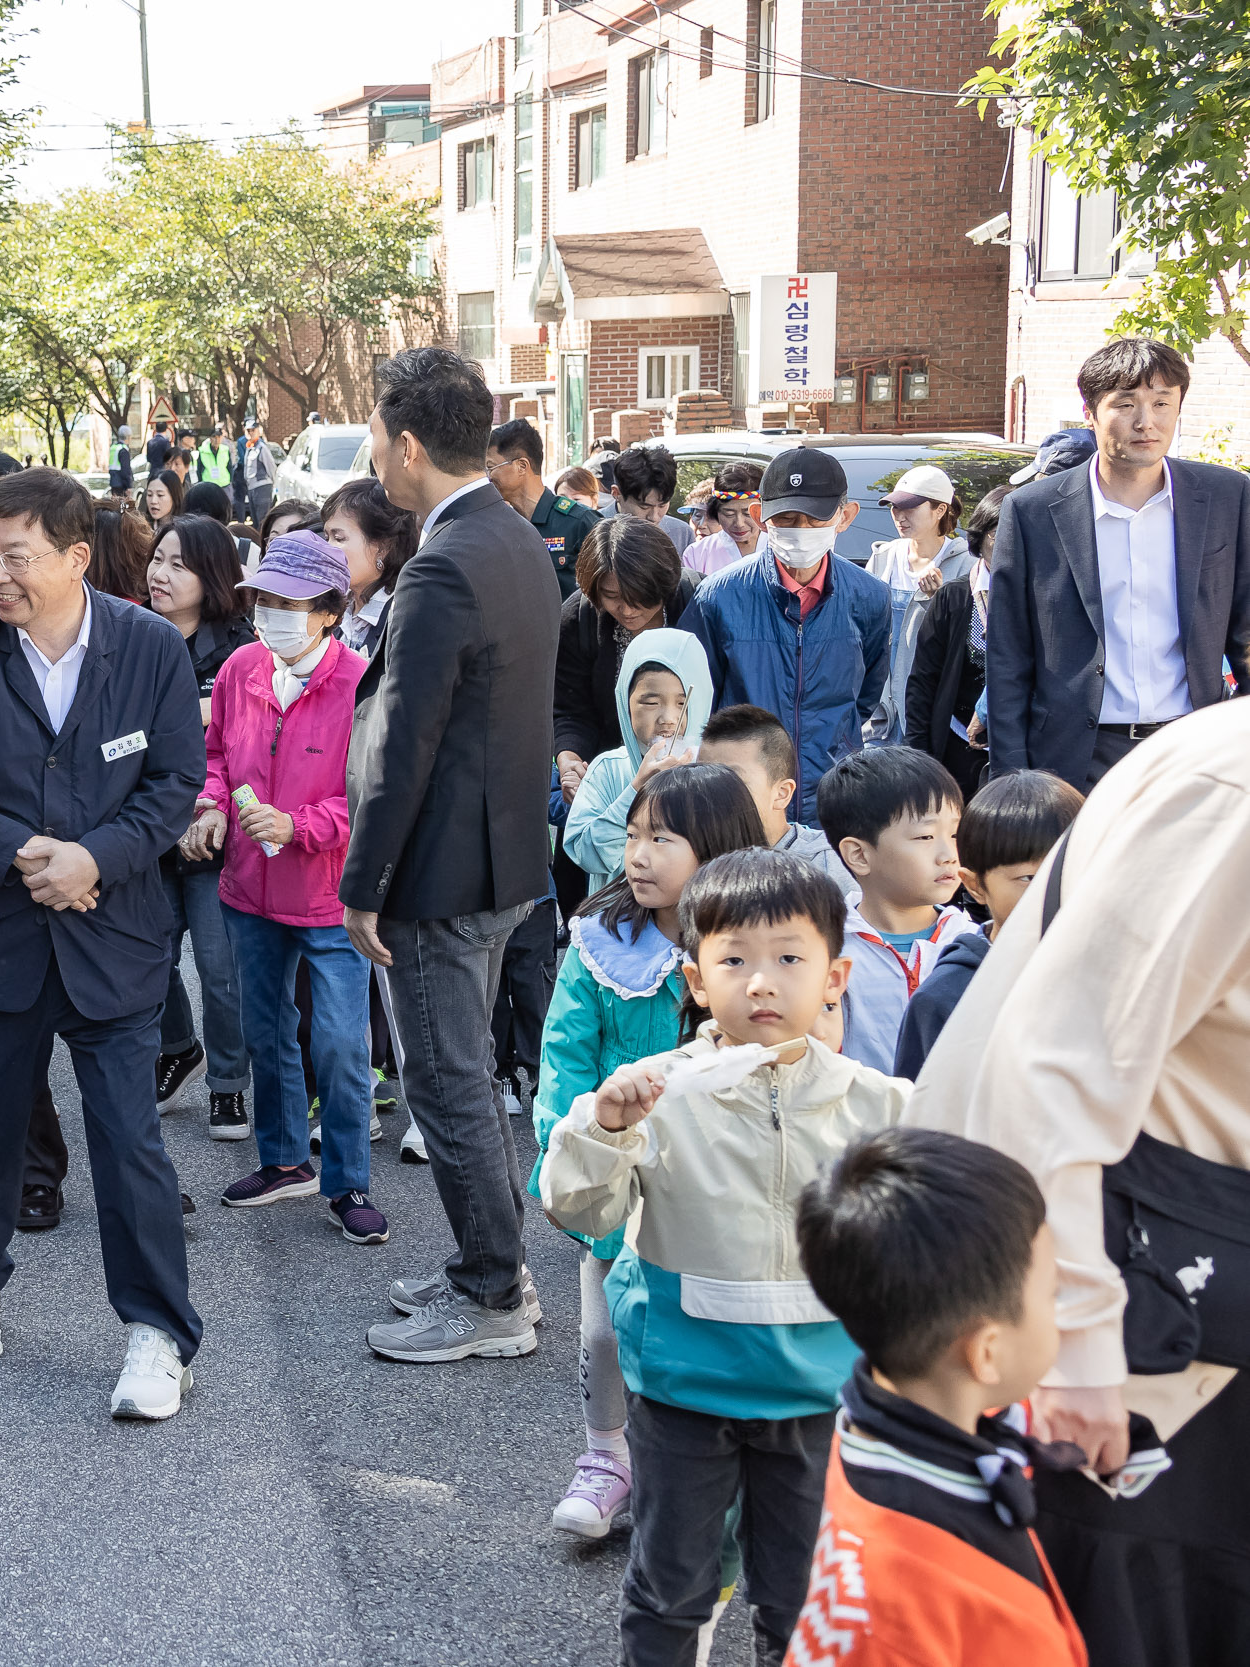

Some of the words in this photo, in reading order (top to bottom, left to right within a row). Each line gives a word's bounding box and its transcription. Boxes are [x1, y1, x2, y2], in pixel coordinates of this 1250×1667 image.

[783, 301, 810, 386] 심령철학
[759, 390, 774, 401] 예약
[775, 389, 833, 401] 010-5319-6666
